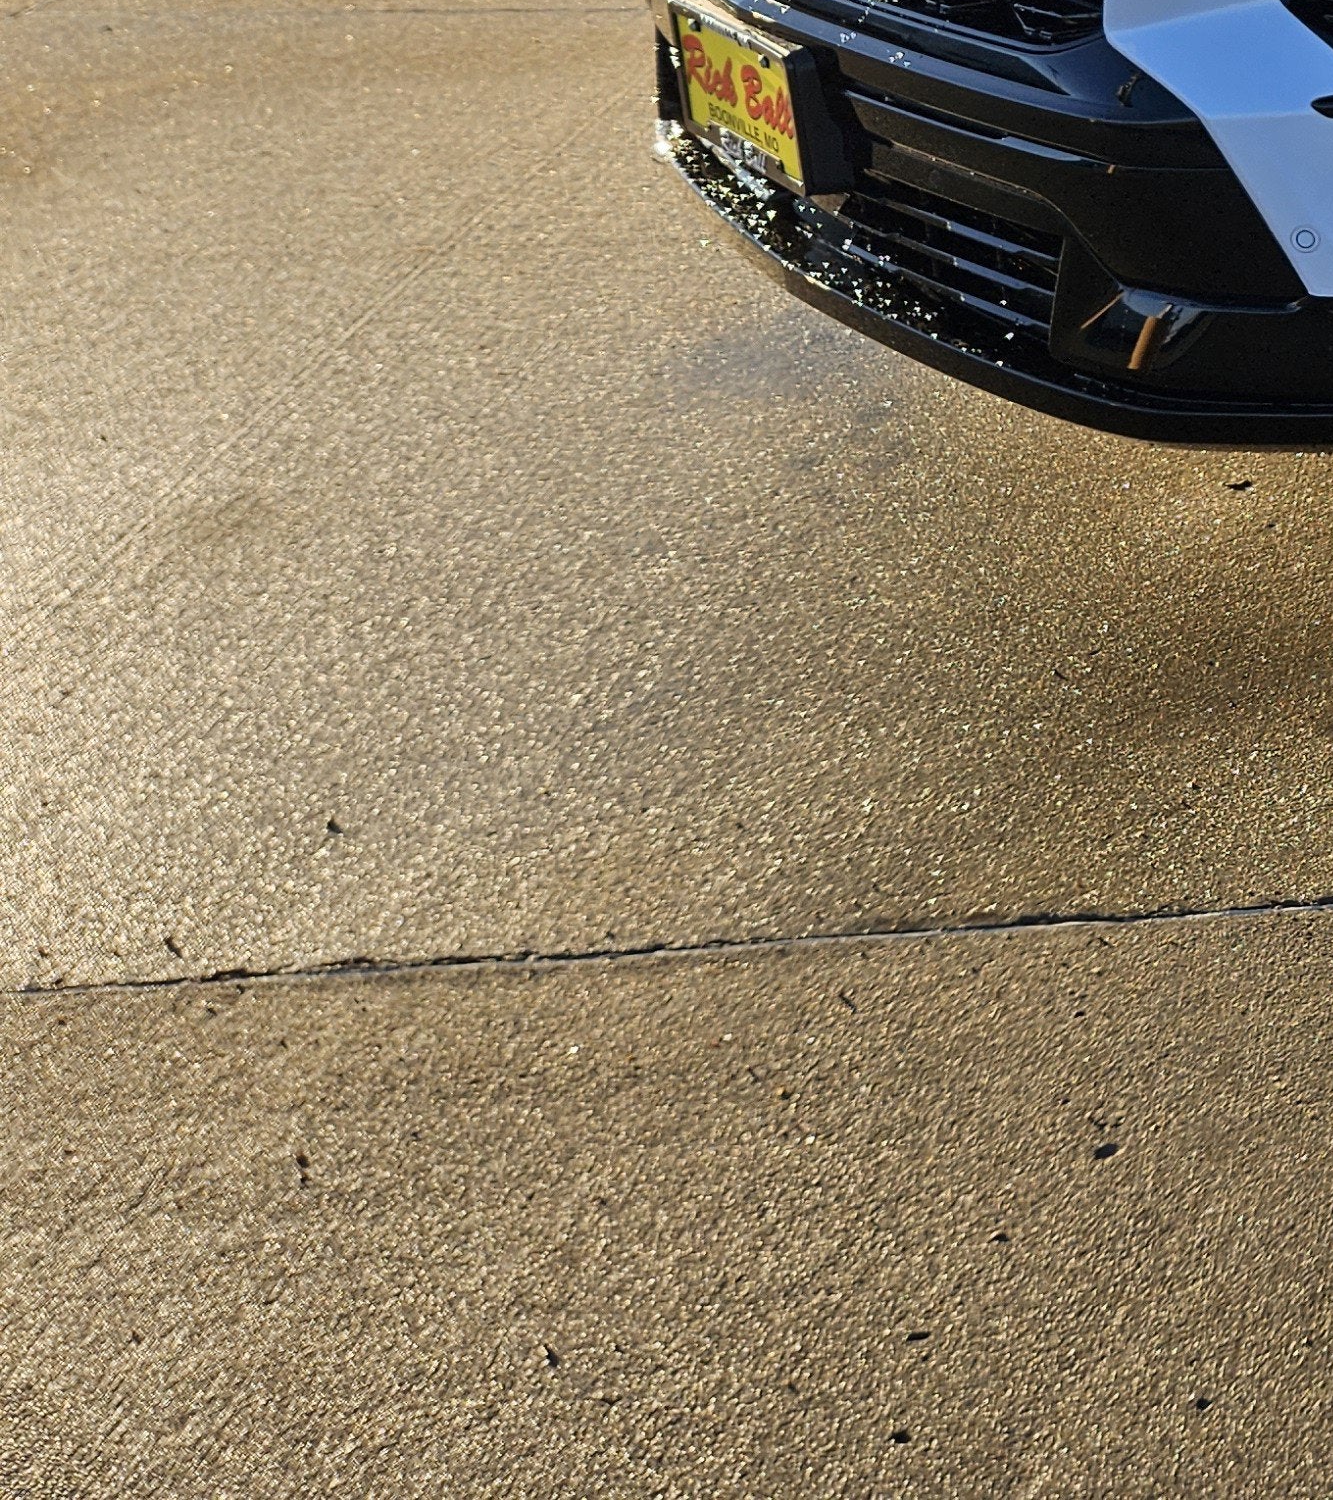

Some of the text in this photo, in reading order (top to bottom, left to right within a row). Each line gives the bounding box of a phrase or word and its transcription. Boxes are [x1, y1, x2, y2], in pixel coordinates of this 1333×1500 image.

[682, 33, 795, 140] Rick Ball
[764, 131, 780, 153] MO
